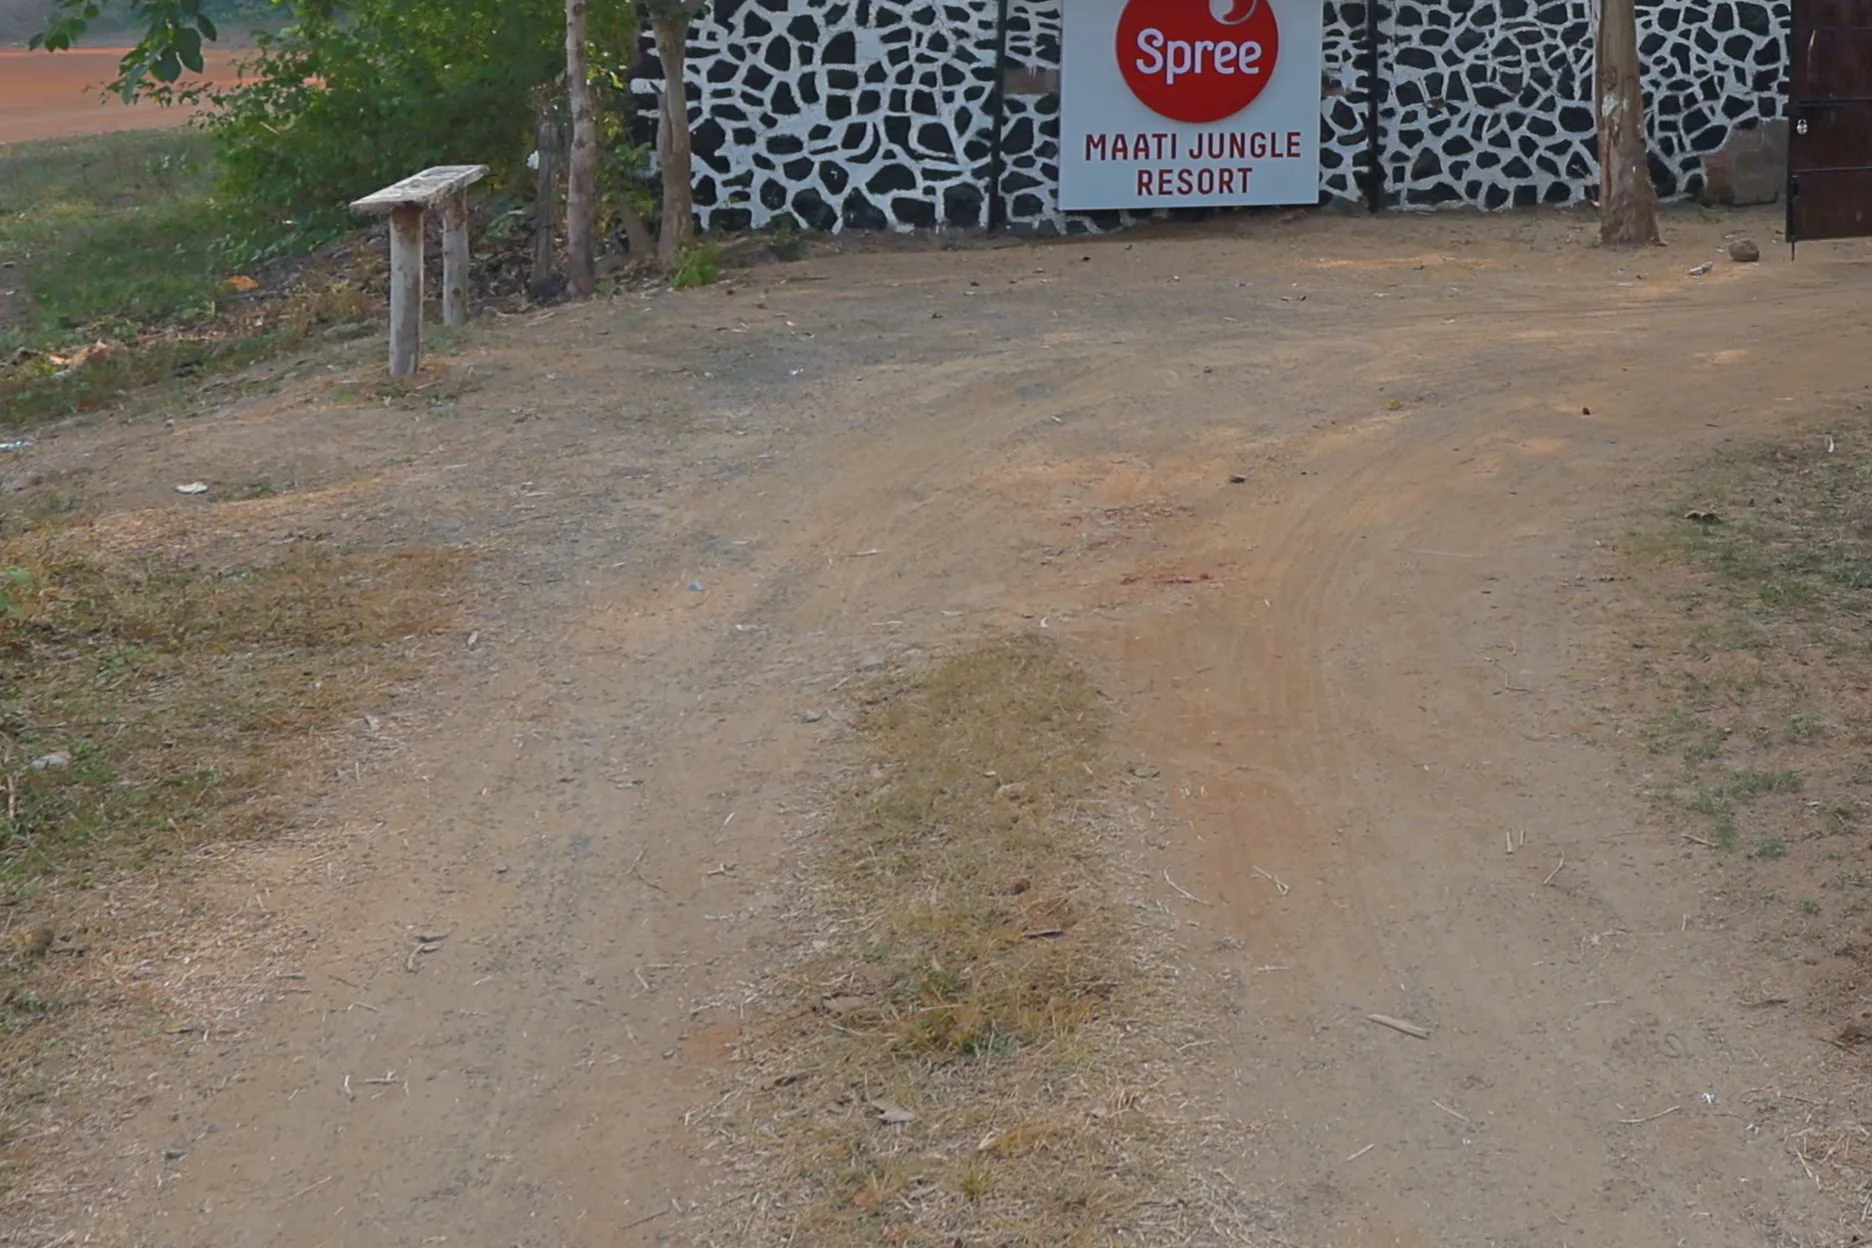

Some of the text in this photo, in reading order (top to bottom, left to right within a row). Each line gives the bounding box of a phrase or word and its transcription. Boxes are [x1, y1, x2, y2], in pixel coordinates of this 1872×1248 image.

[1136, 27, 1262, 85] Spree
[1085, 131, 1301, 161] MAATI JUNGLE
[1137, 167, 1253, 196] RESORT
